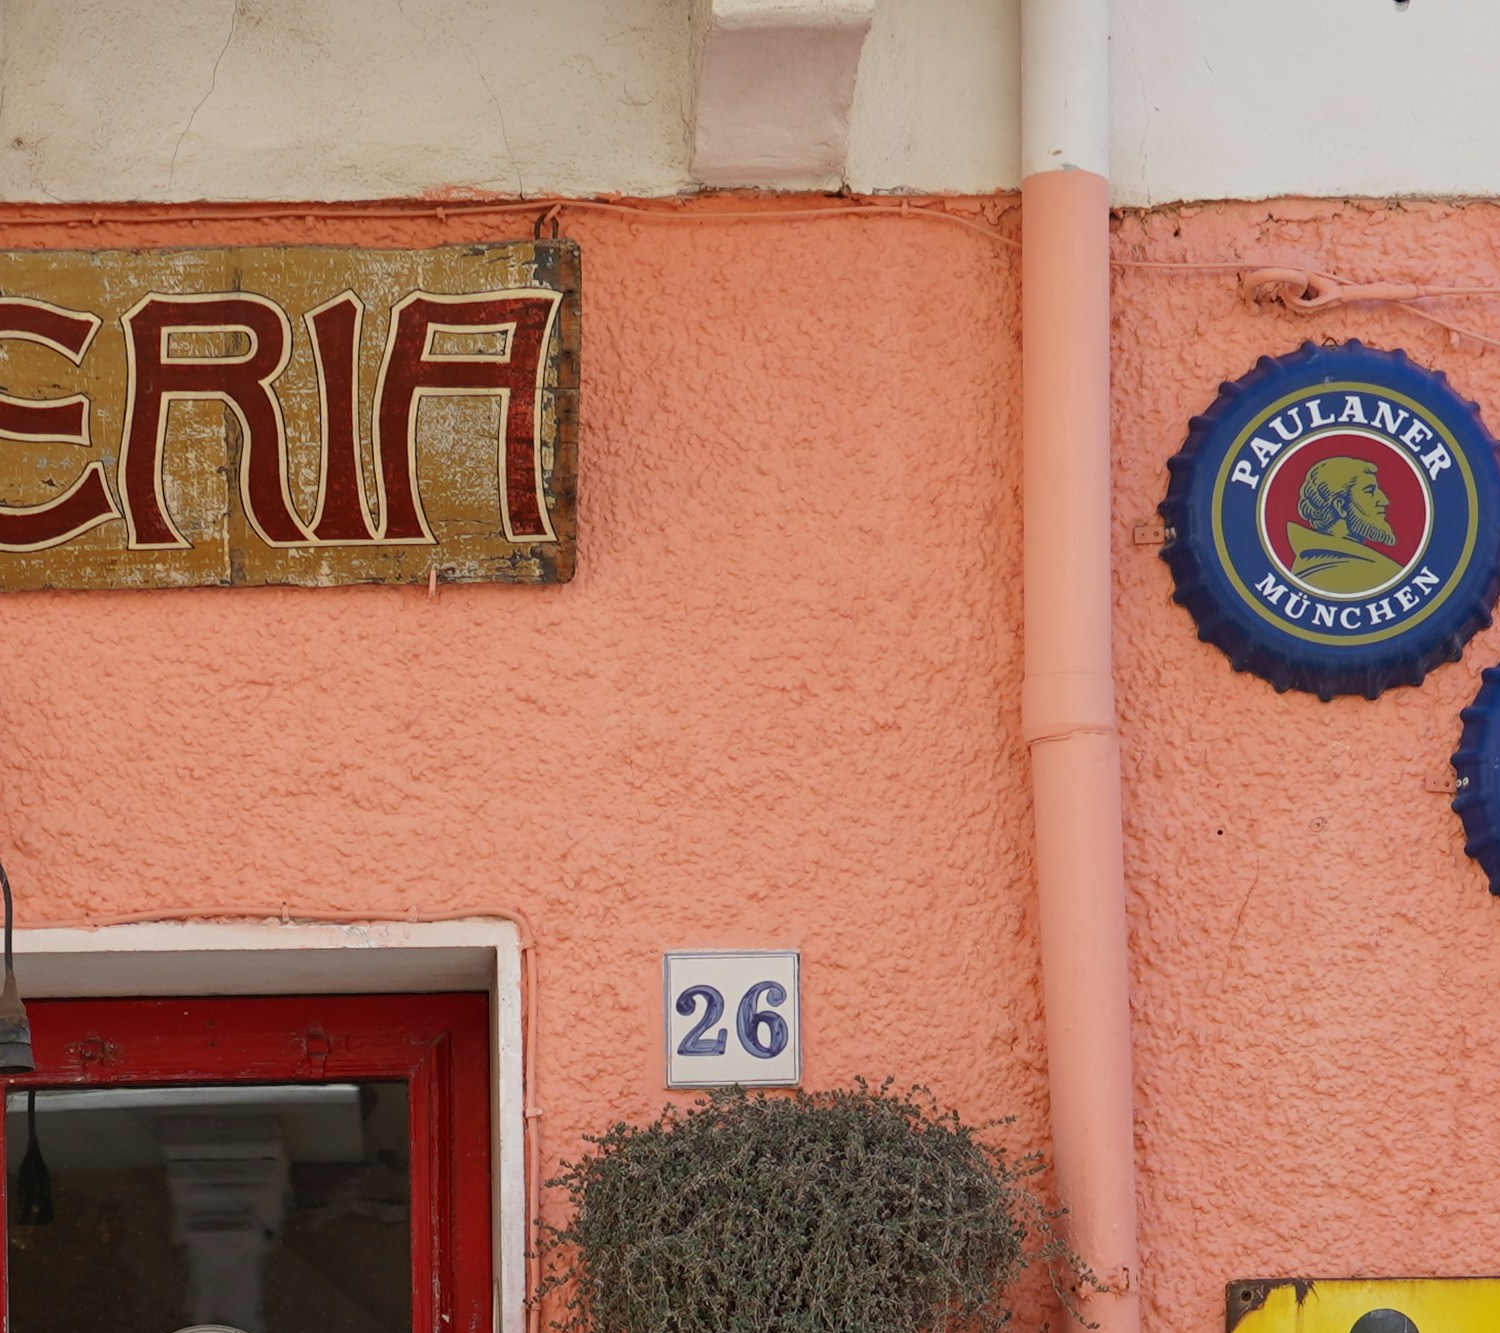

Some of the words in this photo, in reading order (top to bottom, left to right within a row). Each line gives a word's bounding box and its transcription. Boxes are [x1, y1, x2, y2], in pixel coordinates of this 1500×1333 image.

[1230, 395, 1453, 491] PAULANER
[1253, 566, 1441, 629] MÜNCHEN
[676, 981, 789, 1059] 26
